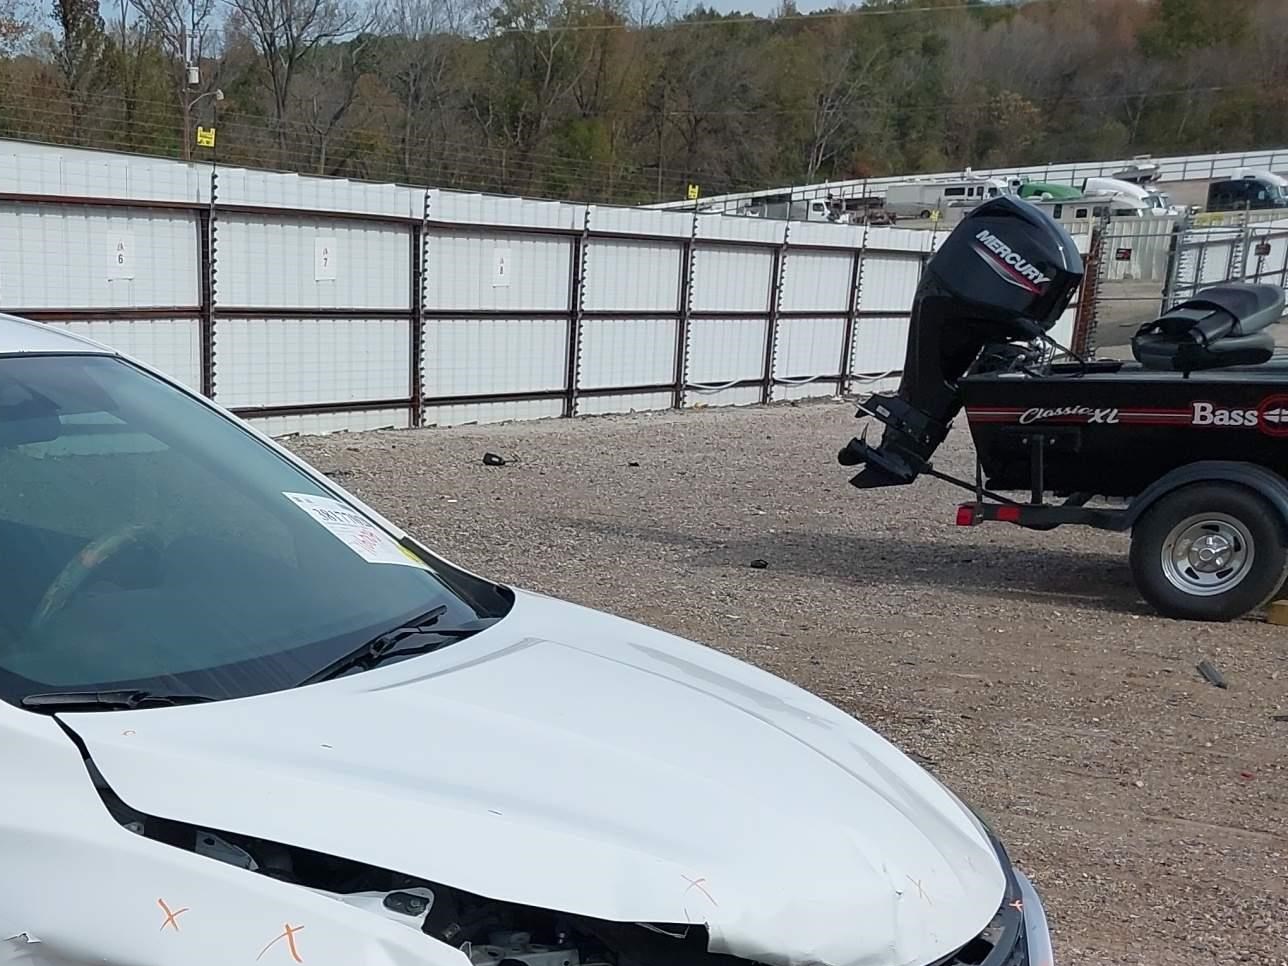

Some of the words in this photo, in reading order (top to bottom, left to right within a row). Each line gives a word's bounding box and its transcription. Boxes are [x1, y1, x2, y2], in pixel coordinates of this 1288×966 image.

[118, 253, 124, 264] 6
[975, 229, 1051, 284] MERCURY
[1019, 404, 1092, 424] Classic
[1087, 407, 1120, 424] XL
[1191, 402, 1259, 426] Bass
